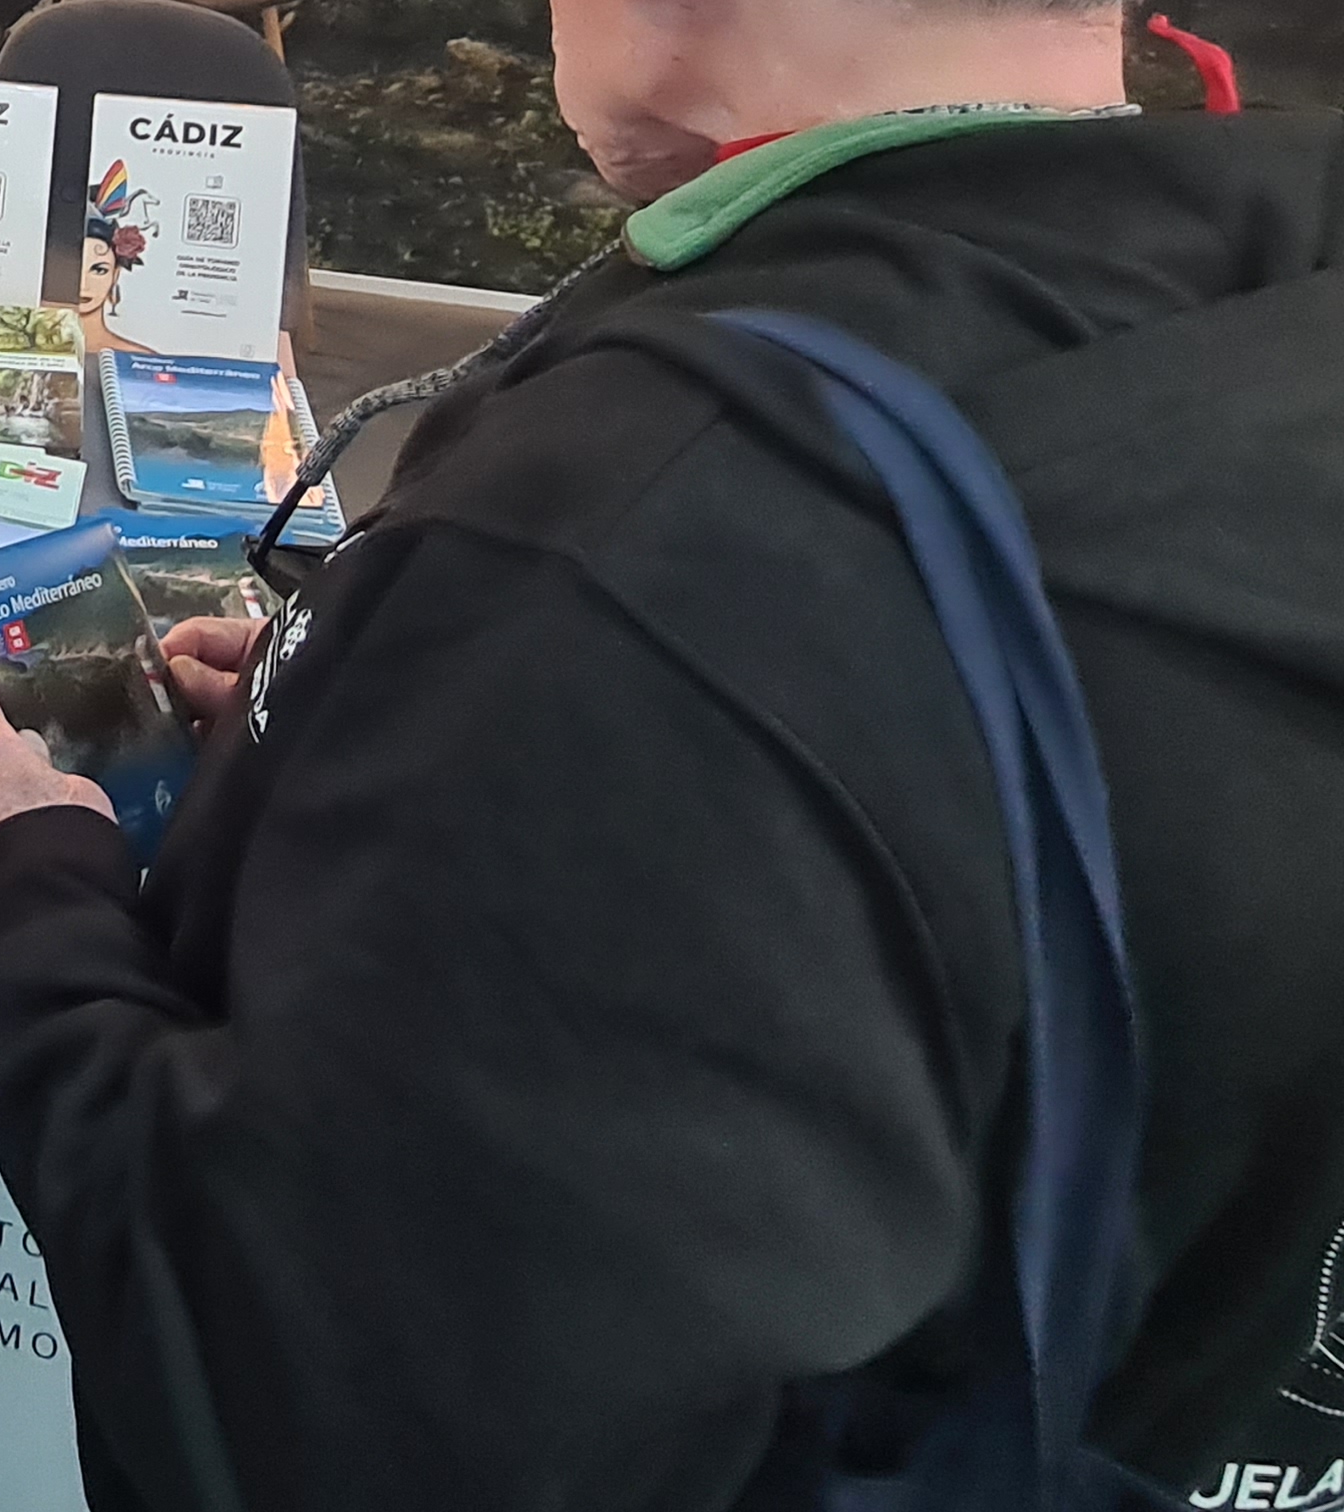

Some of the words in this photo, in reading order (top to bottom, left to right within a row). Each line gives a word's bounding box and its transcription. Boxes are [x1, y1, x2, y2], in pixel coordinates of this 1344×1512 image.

[129, 113, 243, 148] CÁDIZ
[131, 361, 164, 372] Arco
[165, 363, 261, 380] Mediterráneo
[10, 573, 103, 614] Mediterráneo
